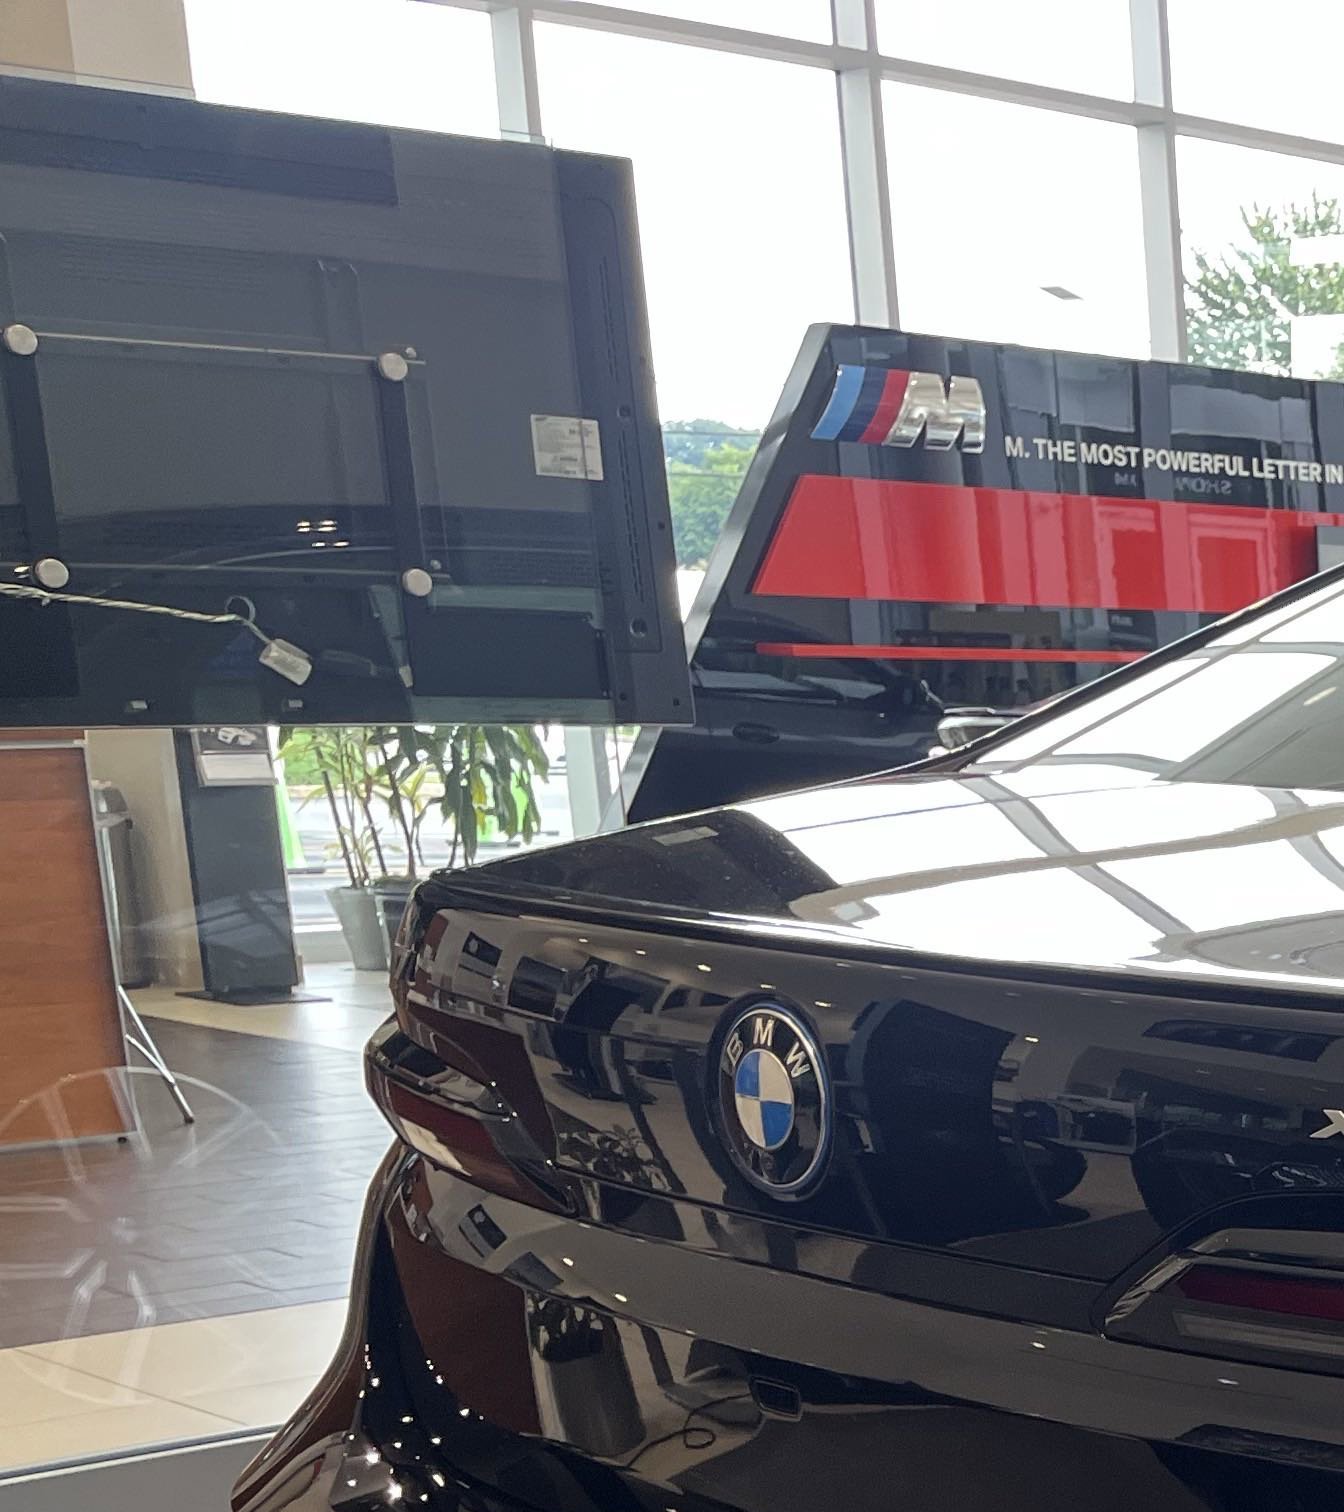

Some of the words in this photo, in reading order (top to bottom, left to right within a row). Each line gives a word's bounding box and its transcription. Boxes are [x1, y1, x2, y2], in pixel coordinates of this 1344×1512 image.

[881, 371, 986, 454] M
[1004, 436, 1031, 459] M.
[1032, 437, 1077, 463] THE
[1080, 442, 1141, 468] MOST
[1142, 447, 1250, 477] POWERFUL
[1252, 457, 1323, 483] LETTER
[1324, 463, 1344, 485] IN
[726, 1016, 811, 1079] BMW
